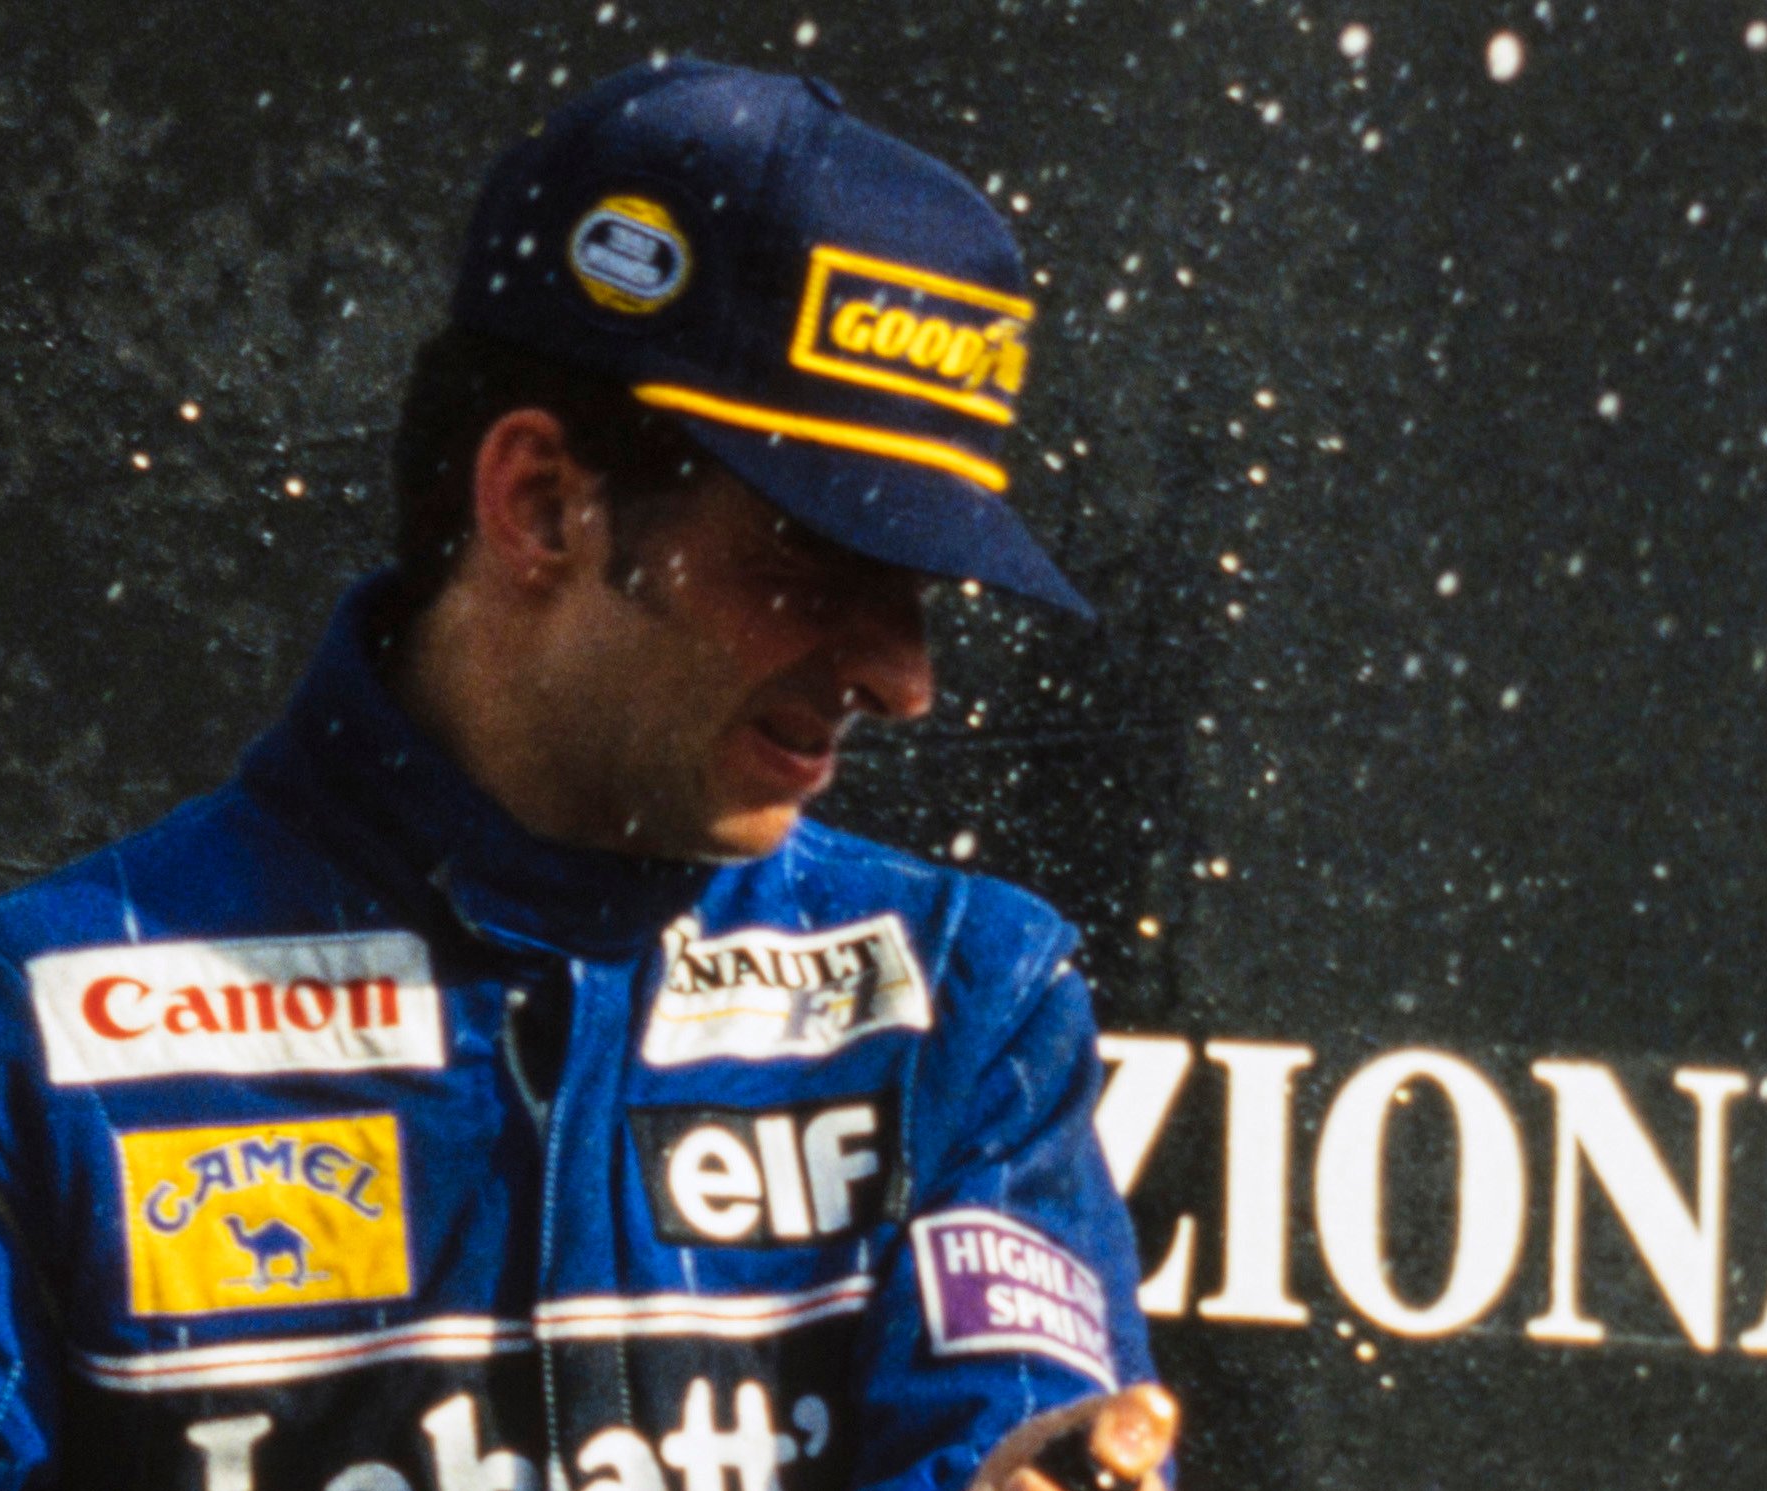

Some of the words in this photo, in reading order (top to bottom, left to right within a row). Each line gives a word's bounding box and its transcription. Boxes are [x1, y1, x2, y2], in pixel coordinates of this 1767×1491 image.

[669, 932, 883, 994] NAULT
[80, 974, 402, 1042] Canon
[143, 1134, 385, 1236] CAMEL
